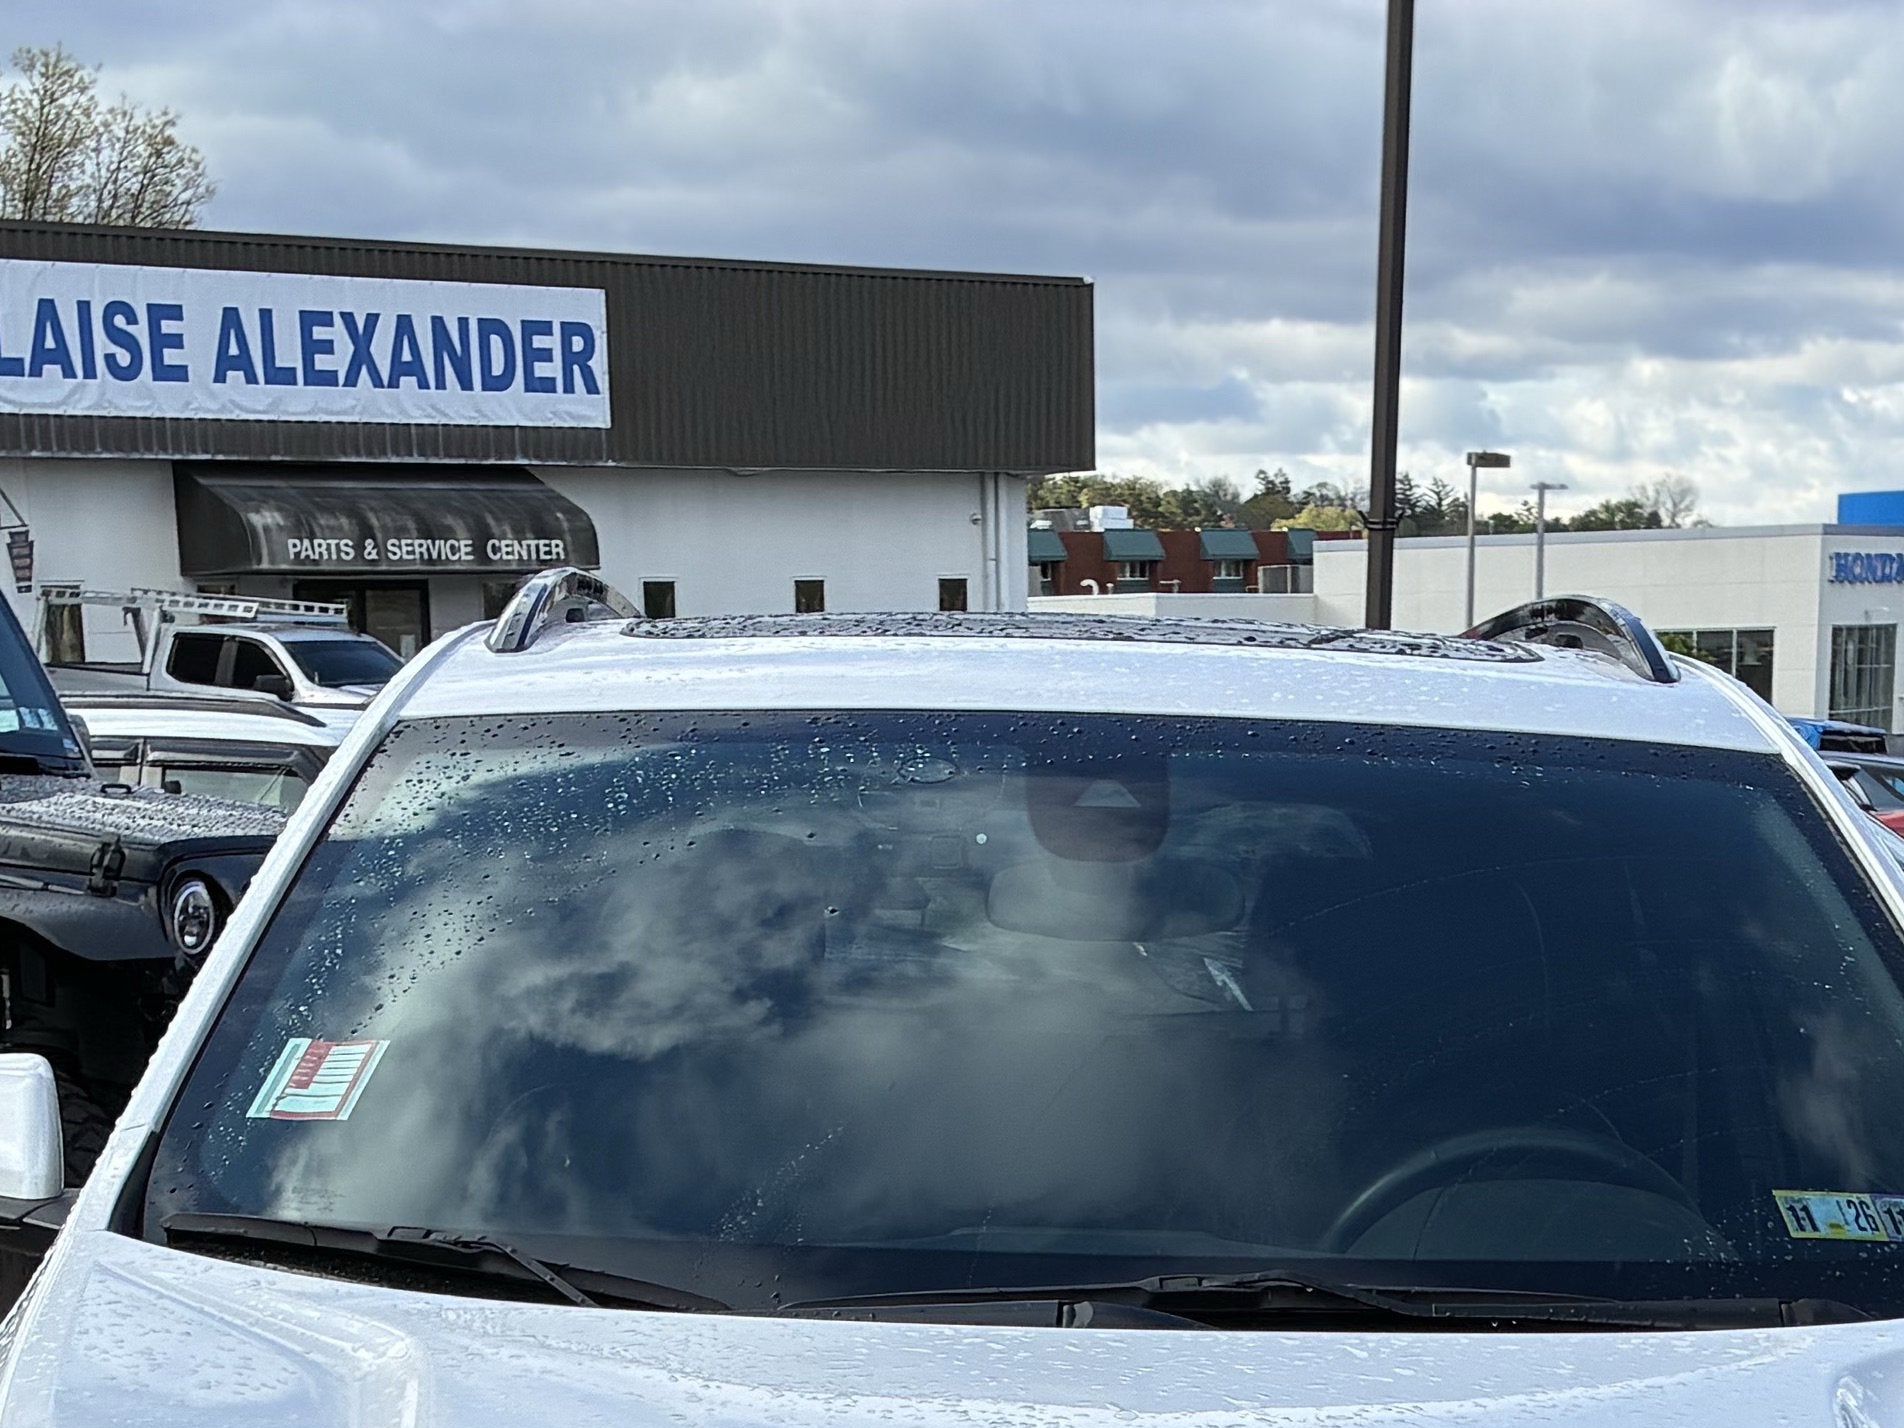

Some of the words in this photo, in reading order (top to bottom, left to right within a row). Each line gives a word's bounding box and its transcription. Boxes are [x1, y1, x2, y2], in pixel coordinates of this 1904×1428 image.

[213, 306, 602, 396] ALEXANDER
[287, 538, 356, 560] PARTS
[363, 538, 379, 560] &
[386, 538, 475, 561] SERVICE
[486, 538, 566, 561] CENTER
[1786, 1203, 1820, 1233] 11
[1847, 1199, 1881, 1233] 26
